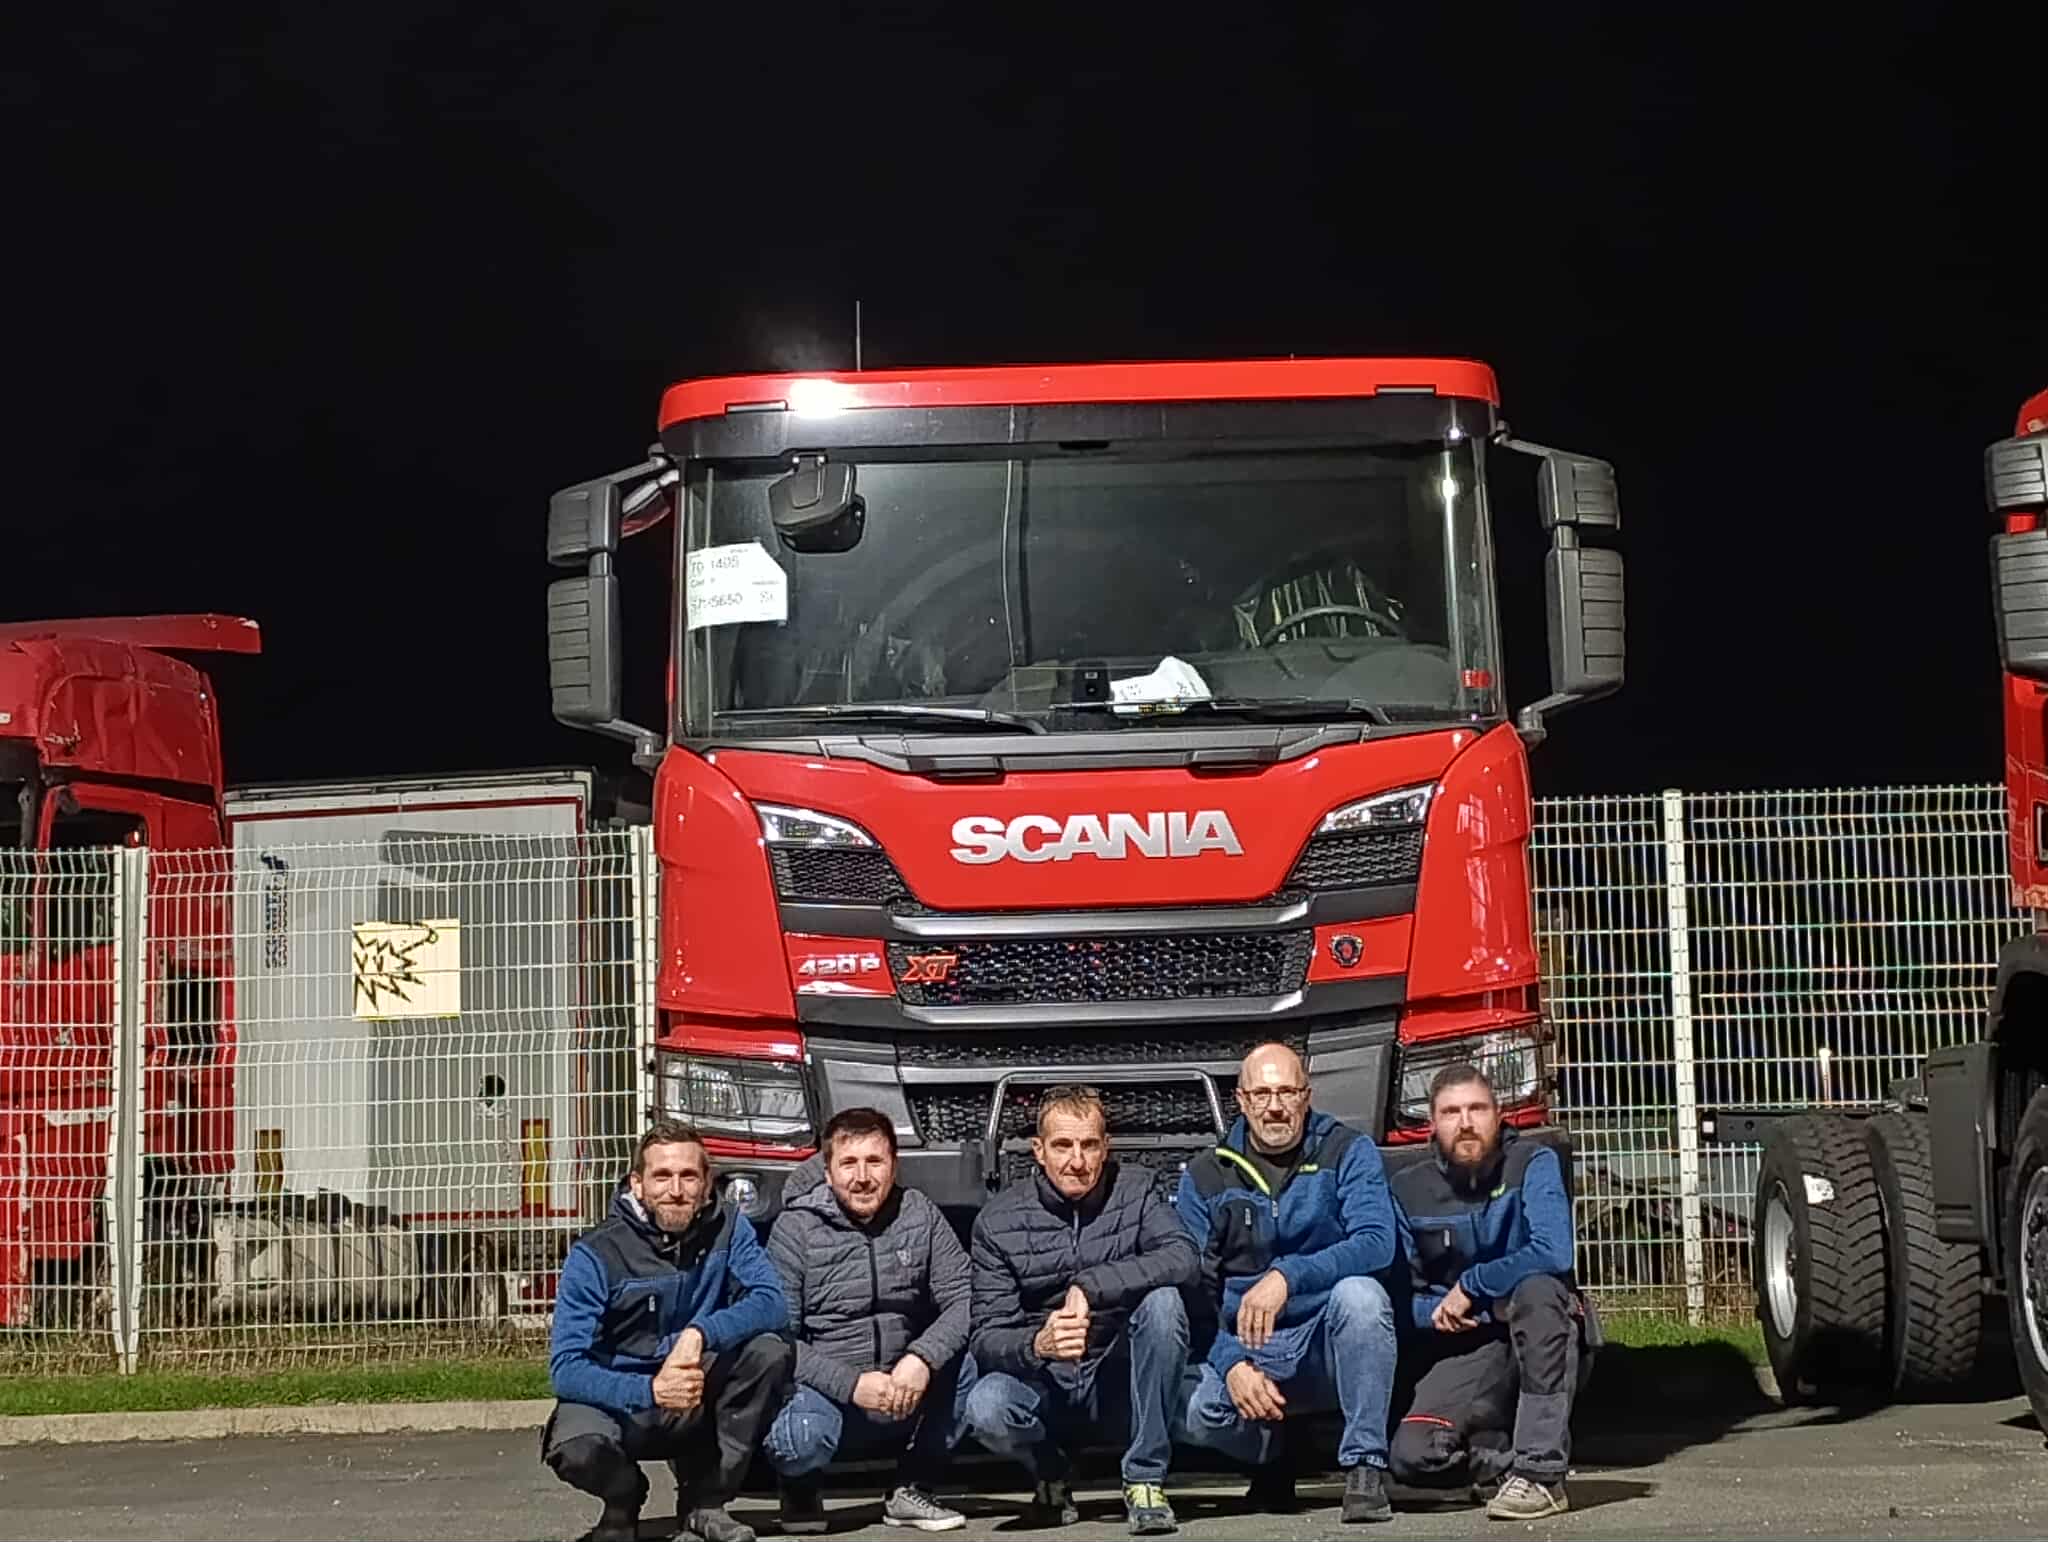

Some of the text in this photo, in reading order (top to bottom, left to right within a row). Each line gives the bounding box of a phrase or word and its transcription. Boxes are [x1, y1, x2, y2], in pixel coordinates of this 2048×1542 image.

[950, 809, 1245, 864] SCANIA
[798, 956, 881, 977] 420 P
[901, 954, 958, 982] XT
